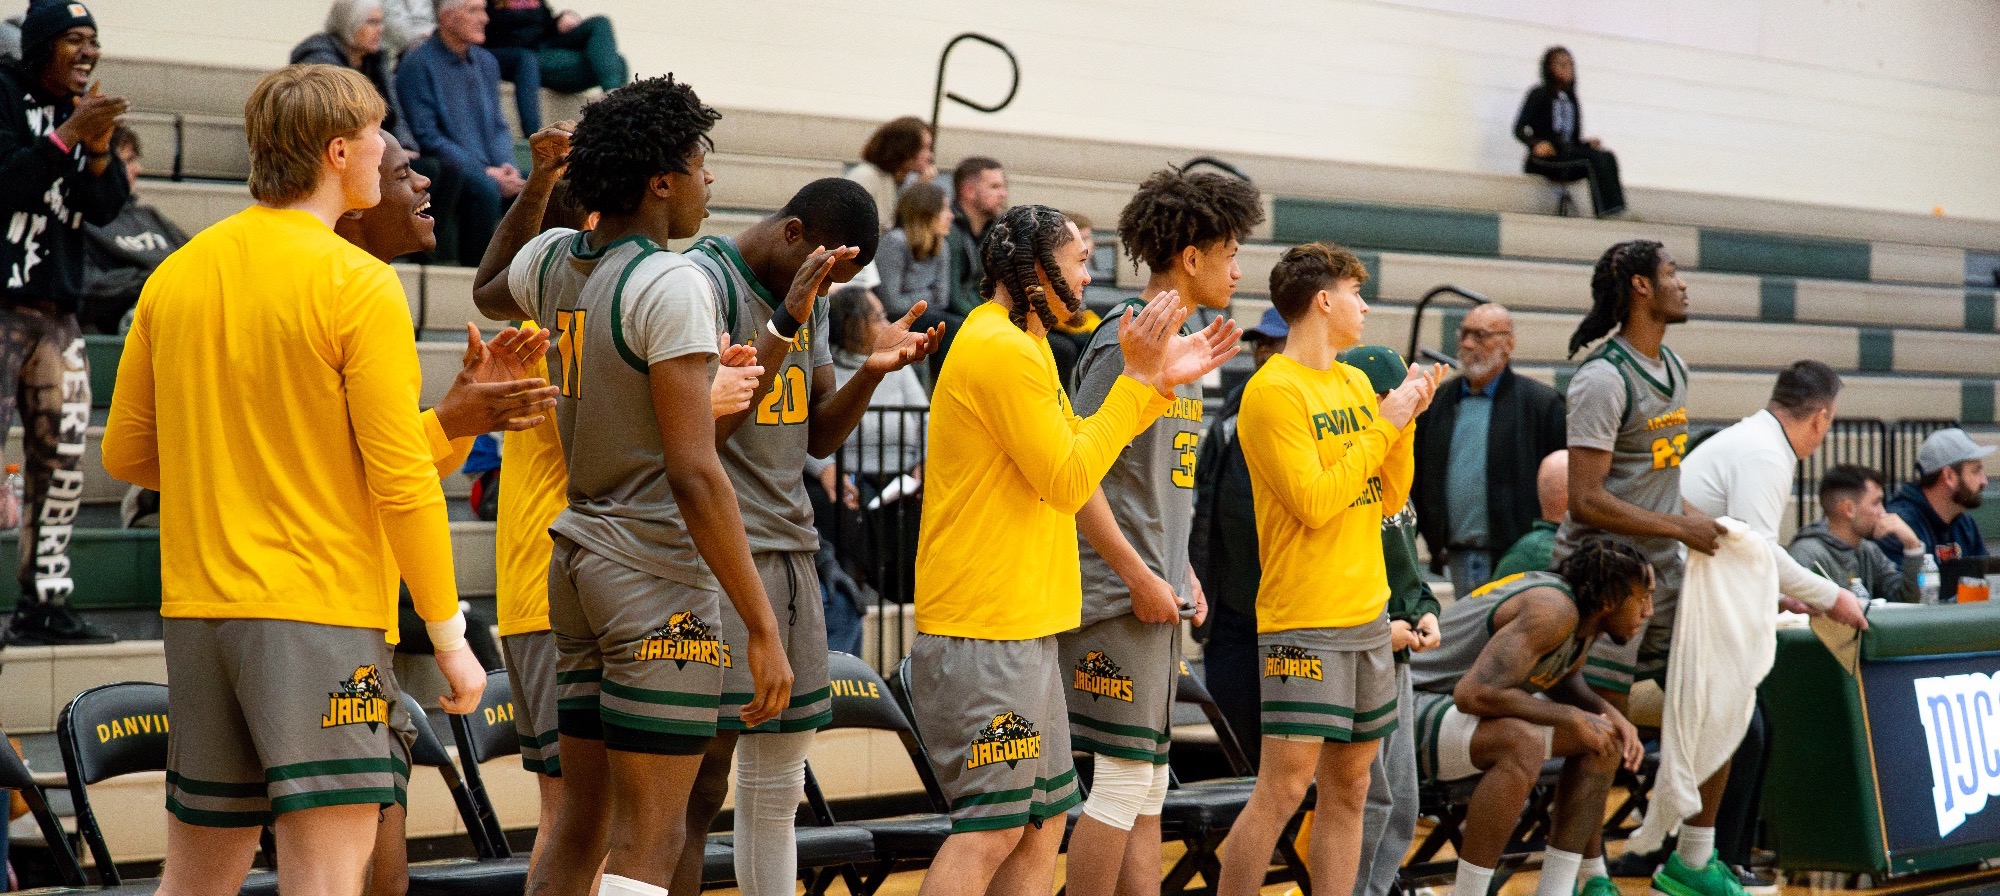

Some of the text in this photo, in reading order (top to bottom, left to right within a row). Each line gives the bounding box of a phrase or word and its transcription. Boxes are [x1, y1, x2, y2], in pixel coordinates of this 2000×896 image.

[754, 364, 811, 426] 20
[1312, 405, 1375, 441] FAMI
[632, 639, 722, 669] JAGUARS
[829, 679, 881, 699] VILLE
[1073, 668, 1134, 704] JAGUARS
[96, 714, 170, 745] DANVIL
[321, 697, 390, 730] JAGUA
[1921, 680, 2000, 826] NJC
